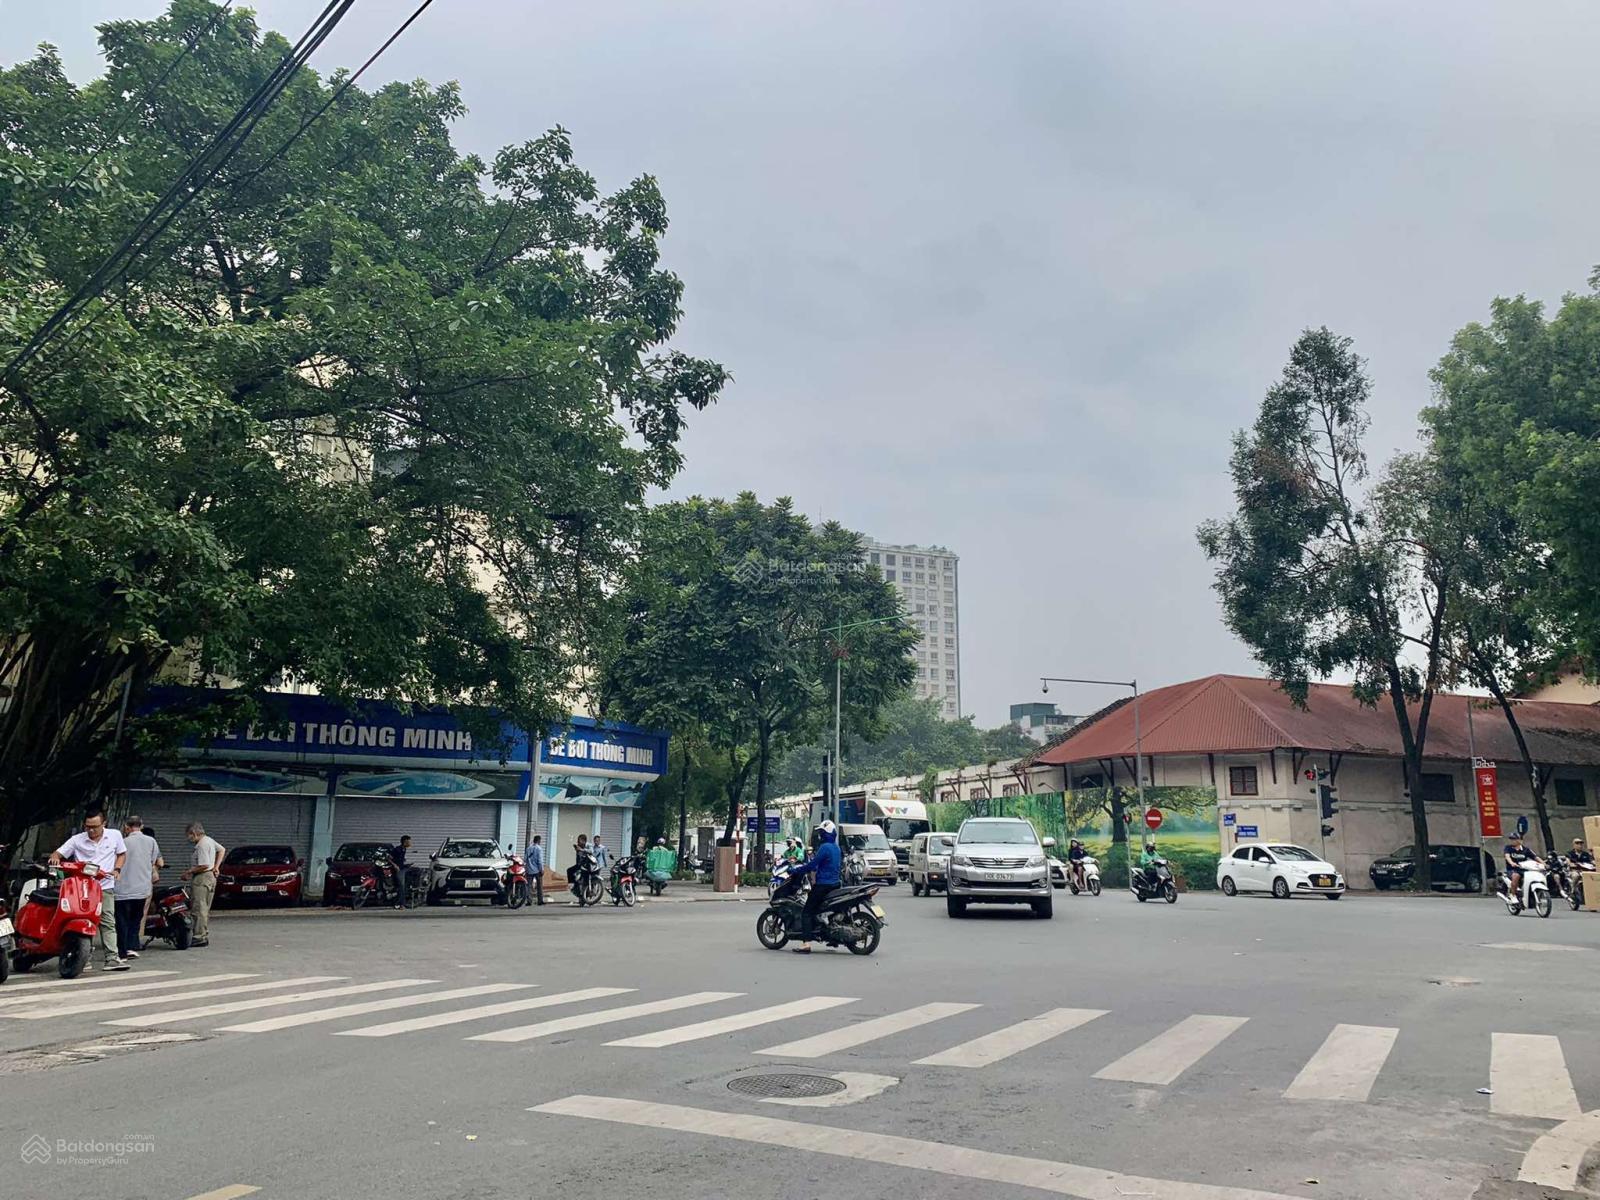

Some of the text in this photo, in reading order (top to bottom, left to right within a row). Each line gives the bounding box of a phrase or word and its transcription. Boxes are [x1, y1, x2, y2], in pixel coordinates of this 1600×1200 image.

[303, 719, 395, 747] THÔNG
[403, 728, 472, 751] MINH
[589, 740, 625, 762] THÔNG
[625, 747, 653, 766] MINH
